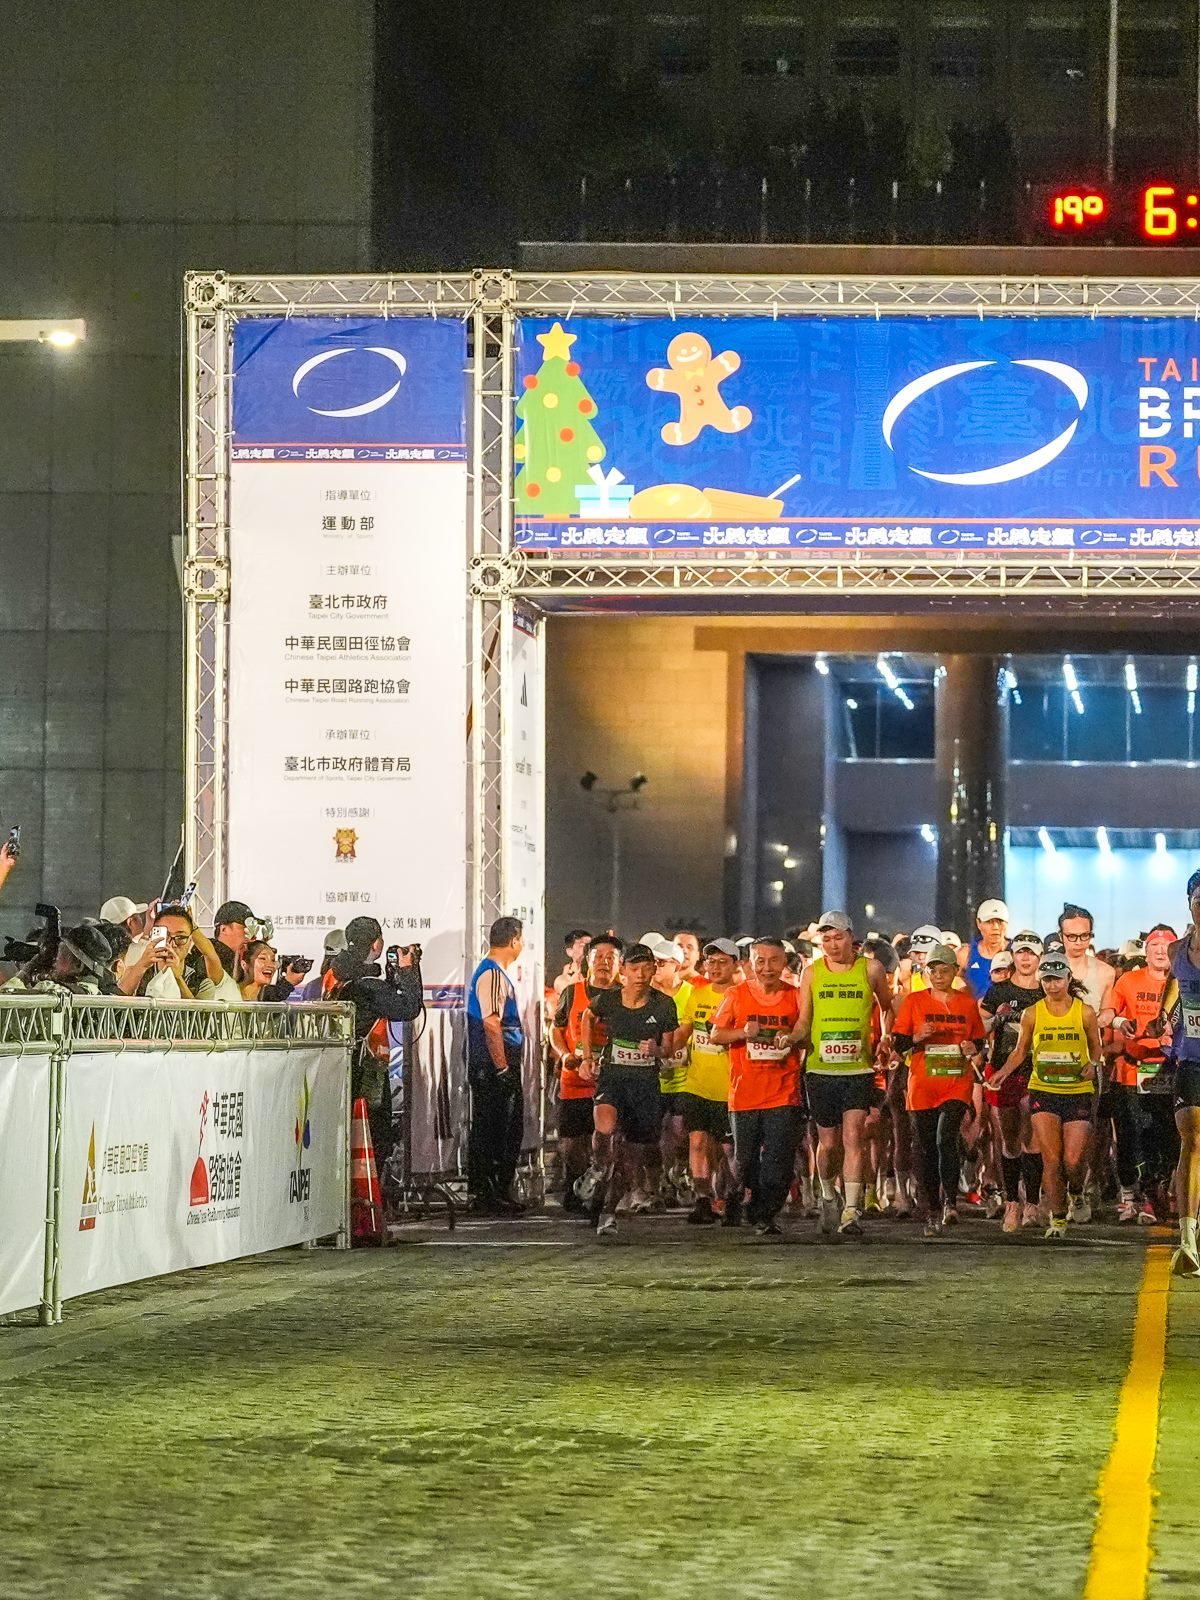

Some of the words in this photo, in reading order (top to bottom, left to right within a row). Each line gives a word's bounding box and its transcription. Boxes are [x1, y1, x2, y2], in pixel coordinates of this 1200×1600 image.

[325, 490, 371, 501] 指導單位
[321, 515, 375, 531] 運動部
[326, 565, 372, 576] 主辦單位
[308, 594, 388, 610] 臺北市政府
[308, 613, 327, 621] Taipei
[329, 612, 343, 621] City
[345, 612, 389, 620] Government
[285, 635, 411, 651] 中華民國田徑協會
[316, 654, 337, 662] Taipei
[284, 679, 411, 694] 中華民國路跑協會
[325, 729, 371, 740] 承辦單位
[284, 756, 411, 772] 臺北市政府體育局
[325, 807, 370, 818] 特別感謝
[325, 892, 371, 903] 協辦單位
[825, 1044, 857, 1054] 8052
